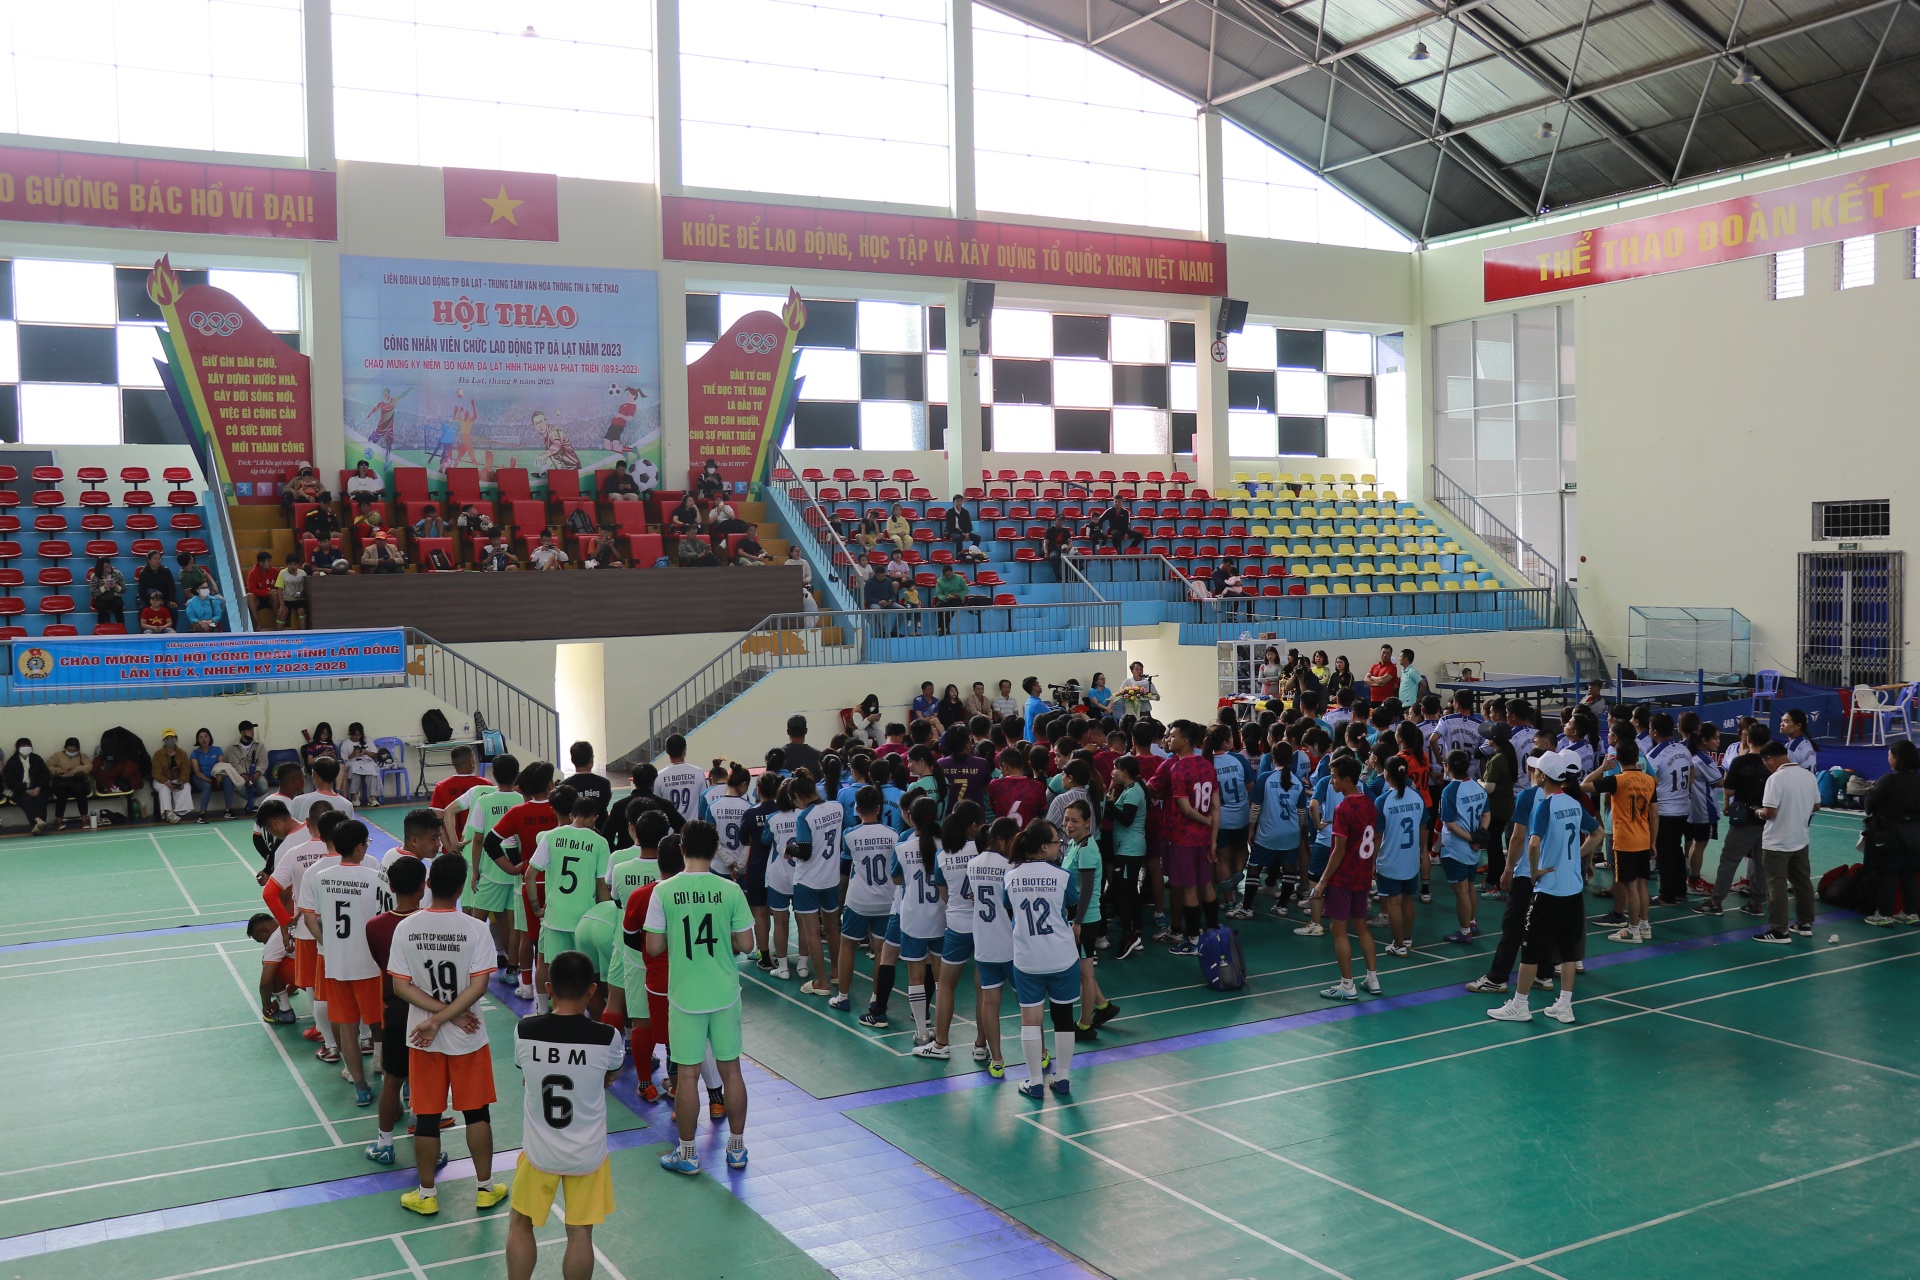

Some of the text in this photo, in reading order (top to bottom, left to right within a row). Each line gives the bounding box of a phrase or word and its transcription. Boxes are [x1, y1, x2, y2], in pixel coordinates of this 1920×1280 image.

[26, 174, 314, 228] GƯƠNG BÁC HỒ VĨ ĐẠI!
[1536, 175, 1890, 282] THỂ THAO ĐOÀN KẾT
[682, 214, 1215, 285] KHỎE ĐỂ LAO ĐỘNG, HỌC TẬP VÀ XÂY DỰNG TỔ QUỐC XHCN VIỆT NAM!
[383, 273, 398, 284] LIÊN
[400, 274, 417, 286] ĐOÀN
[419, 276, 431, 286] LAO
[433, 275, 450, 288] ĐỘNG
[452, 277, 460, 287] TP
[461, 276, 470, 287] ĐÀ
[472, 278, 482, 290] LẠT
[488, 279, 509, 290] TRUNG
[510, 279, 523, 290] TÂM
[525, 279, 537, 291] VĂN
[574, 282, 584, 293] TIN
[586, 283, 590, 293] &
[592, 280, 602, 294] THỂ
[604, 284, 619, 294] THAO
[432, 294, 578, 331] HỘI THAO
[384, 334, 621, 358] CÔNG NHÂN VIÊN CHỨC LAO ĐỘNG TP ĐÀ LẠT NĂM 2023
[202, 355, 218, 368] GIỮ
[220, 355, 235, 368] GÌN
[237, 355, 255, 368] DÂN
[444, 361, 455, 370] 130
[207, 372, 298, 387] XÂY DỰNG NƯỚC NHÀ,
[730, 369, 771, 382] ĐẦU TƯ CHO
[214, 389, 295, 403] GÂY ĐỜI SỐNG MỚI,
[703, 382, 766, 396] THỂ DỤC THỂ THAO
[220, 405, 297, 420] VIỆC GÌ CŨNG CẦN
[727, 399, 762, 411] LÀ ĐẦU TƯ
[226, 424, 238, 436] CÓ
[240, 424, 258, 436] SỨC
[704, 415, 719, 425] CHO
[721, 415, 735, 426] CON
[689, 428, 755, 442] CHO SỰ PHÁT TRIỂN
[232, 440, 305, 453] MỚI THÀNH CÔNG
[700, 443, 752, 456] CỦA ĐẤT NƯỚC.
[60, 643, 399, 666] CHÀO MỪNG ĐẠI HỘI CÔNG ĐOÀN TỈNH LÂM ĐỒNG
[121, 666, 149, 679] LẦN
[154, 667, 182, 678] THỨ
[204, 664, 249, 677] NHIỆM
[254, 664, 272, 674] KỲ
[276, 661, 347, 673] 2023-2028
[671, 774, 695, 782] BIOTECH
[1670, 765, 1689, 793] 15
[954, 778, 968, 802] 7
[1193, 781, 1213, 813] 18
[670, 787, 691, 814] 99
[1628, 793, 1648, 823] 19
[822, 811, 842, 824] BIOTECH
[1007, 800, 1024, 828] 6
[725, 823, 740, 851] 9
[864, 837, 893, 846] BIOTECH
[1359, 825, 1375, 859] 8
[1400, 816, 1414, 850] 3
[555, 837, 594, 852] GO! Đà Lạt
[822, 829, 836, 860] 3
[905, 851, 914, 859] F1
[558, 855, 580, 895] 5
[862, 853, 888, 887] 10
[976, 866, 1006, 876] BIOTECH
[331, 879, 360, 888] TY CP KHOÁNG
[625, 874, 640, 886] GO!
[913, 868, 941, 904] 15
[1011, 877, 1057, 887] F1 BIOTECH
[673, 890, 723, 905] GO! Đà Lạt
[978, 885, 997, 923] 5
[335, 900, 351, 939] 5
[1020, 897, 1054, 937] 12
[408, 932, 468, 943] CÔNG TY CP KHOÁNG SẢN
[682, 913, 718, 961] 14
[416, 942, 460, 953] VÀ VLXD LÂM ĐỒNG
[424, 958, 458, 1003] 19
[541, 1073, 574, 1130] 6
